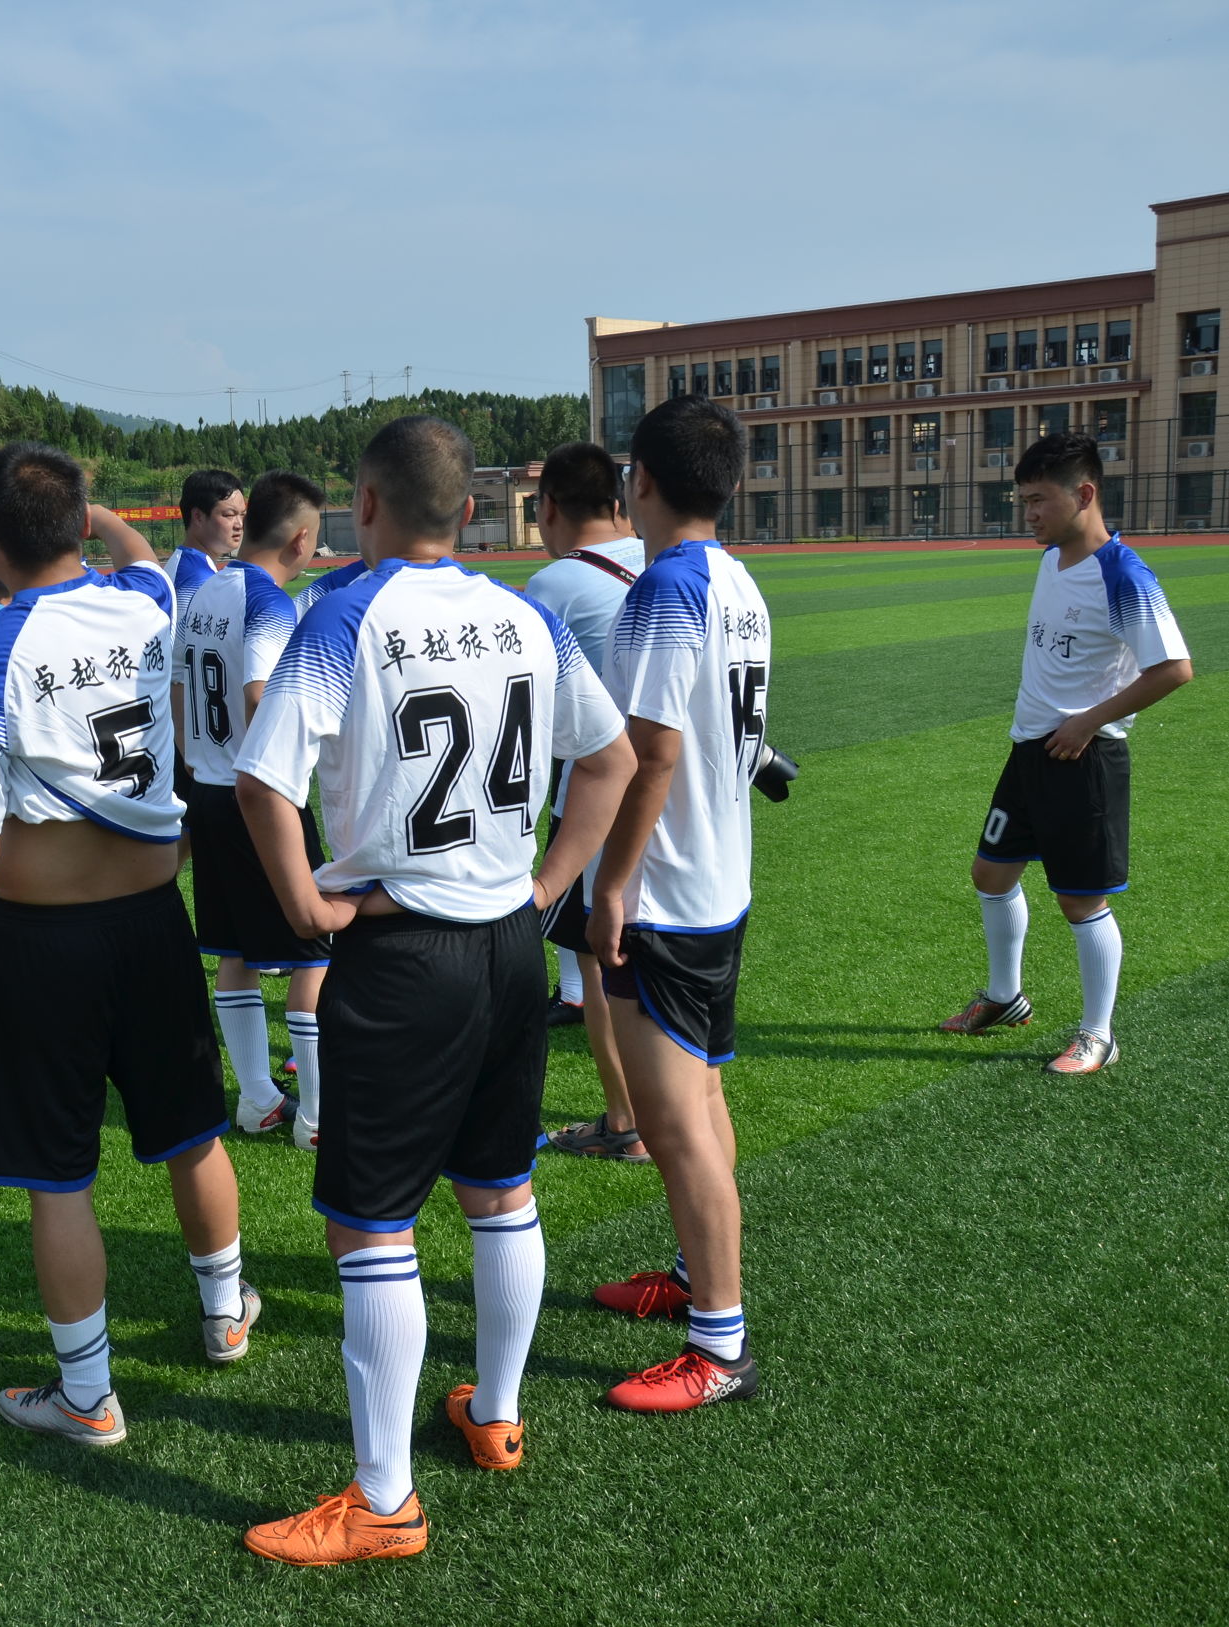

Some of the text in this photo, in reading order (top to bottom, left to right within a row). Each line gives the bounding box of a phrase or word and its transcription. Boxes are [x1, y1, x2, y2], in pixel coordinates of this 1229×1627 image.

[34, 636, 164, 706] 卓越旅游
[185, 644, 233, 747] 18
[381, 619, 523, 676] 卓越旅游
[86, 695, 159, 800] 5
[392, 673, 534, 856] 24
